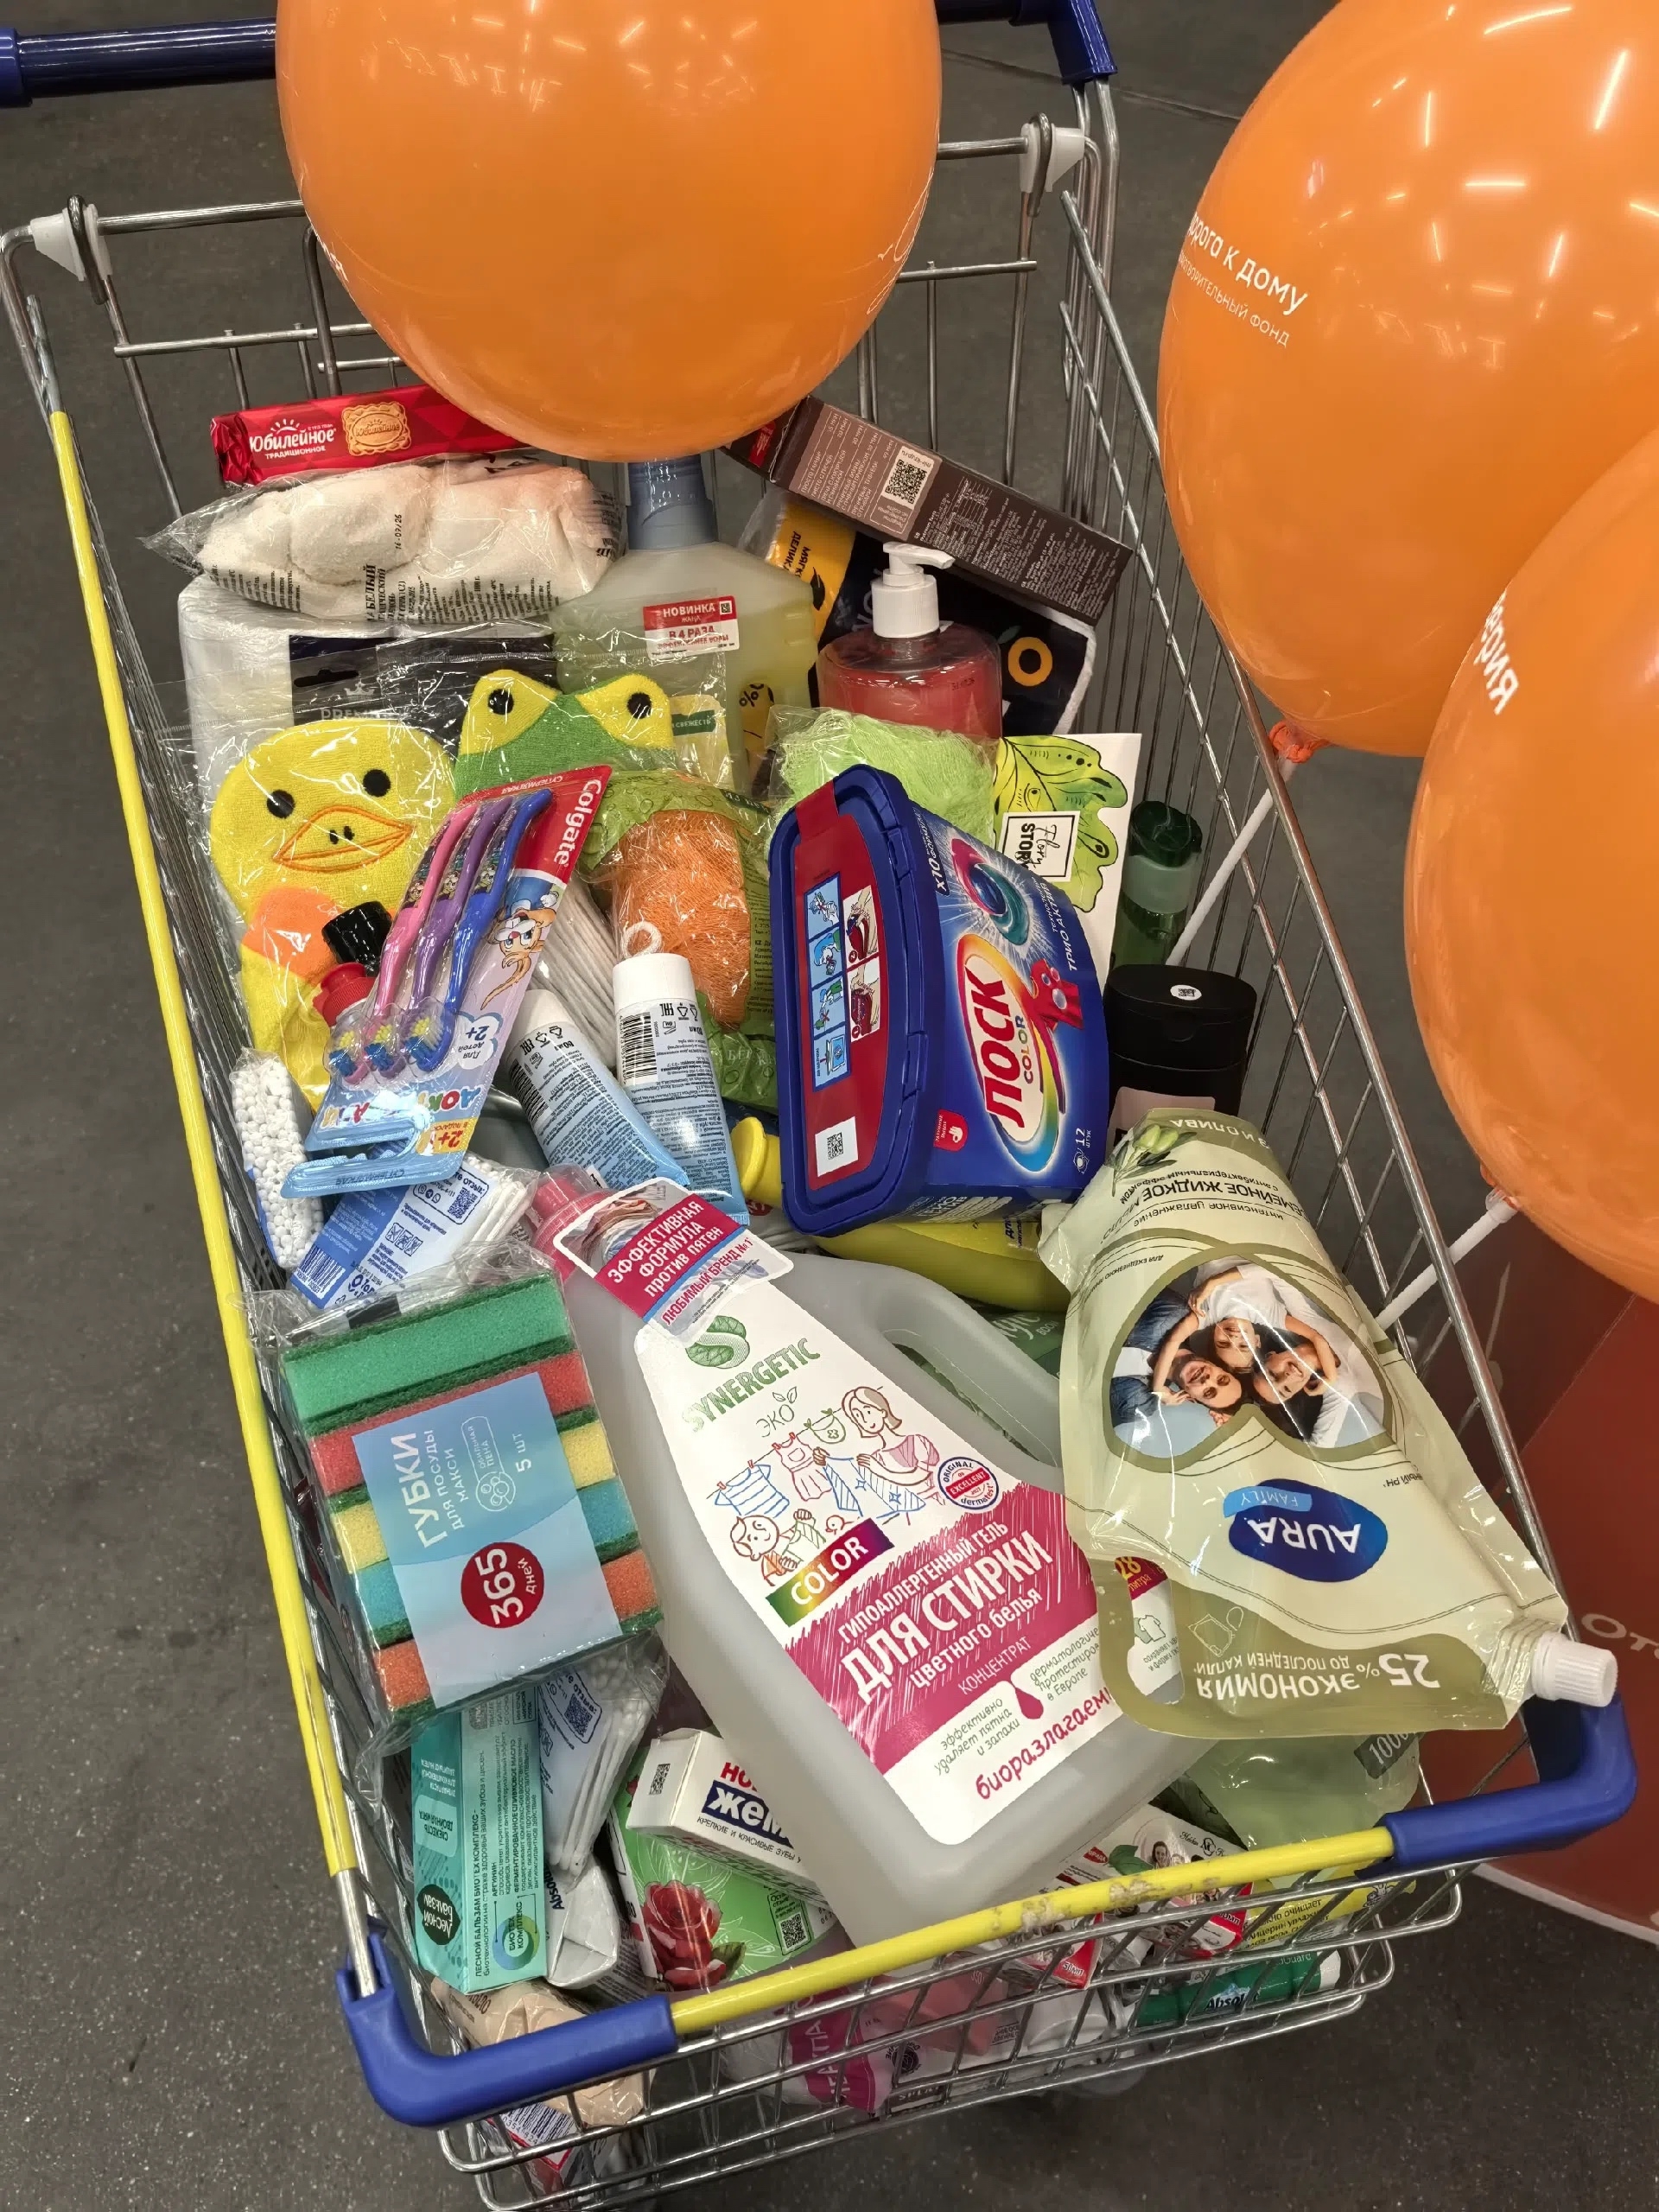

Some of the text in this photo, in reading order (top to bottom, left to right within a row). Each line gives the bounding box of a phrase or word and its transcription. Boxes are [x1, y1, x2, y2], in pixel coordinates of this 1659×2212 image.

[1249, 313, 1290, 348] ФОНД
[248, 424, 334, 452] Юбилейное
[264, 445, 326, 459] ТРАДИЦИОННОЕ
[361, 563, 376, 609] БЕЛЫЙ
[663, 602, 715, 617] НОВИНКА
[554, 780, 601, 867] Colgate
[1058, 929, 1077, 972] ТРИО
[464, 1025, 492, 1041] 2+
[967, 968, 1025, 1128] ЛОСК
[1015, 1016, 1036, 1084] COLOR
[1075, 1127, 1085, 1146] 12
[1168, 1119, 1237, 1134] ОЛИВА
[1140, 1174, 1222, 1203] ЖИДКОЕ
[1166, 1172, 1271, 1188] антибактериальным
[603, 1195, 705, 1285] ЭФФЕКТИВНАЯ
[635, 1217, 706, 1280] ФОРМУЛА
[644, 1251, 691, 1300] против
[686, 1223, 724, 1258] пятен
[659, 1269, 713, 1325] ЛЮБИМЫЙ
[707, 1246, 741, 1278] БРЕНД
[677, 1332, 823, 1434] SYNERGETIC
[442, 1446, 469, 1503] МАКСИ
[479, 1439, 496, 1467] ПЕНА
[514, 1457, 532, 1472] 5
[943, 1460, 974, 1482] ORIGINAL
[386, 1428, 448, 1549] ГУБКИ
[420, 1428, 466, 1529] ДЛЯ ПОСУДЫ
[950, 1471, 986, 1494] EXCELLENT
[1240, 1490, 1299, 1506] FAMILY
[1247, 1515, 1361, 1553] AURA
[473, 1544, 526, 1625] 365
[790, 1537, 869, 1609] COLOR
[834, 1516, 1009, 1644] ГИПОАЛЛЕРГЕННЫЙ ГЕЛЬ
[839, 1522, 1055, 1706] ДЛЯ СТИРКИ
[906, 1581, 1044, 1693] цветного белья
[956, 1634, 1036, 1698] КОНЦЕНТРАТ
[1027, 1625, 1103, 1683] дерматологиче
[1035, 1640, 1104, 1694] протестиров
[1196, 1650, 1350, 1674] ДО ПОСЛЕДНЕЙ КАПЛИ
[1052, 1665, 1090, 1698] Европе
[1194, 1670, 1359, 1700] ЭКОНОМИЯ
[933, 1708, 1015, 1777] удаляет пятна
[937, 1695, 1007, 1751] эффективно
[982, 1716, 1023, 1751] запахи
[479, 1783, 487, 1806] зубов
[696, 1815, 728, 1834] КРЕПКИЕ
[737, 1832, 774, 1853] КРАСИВЫЕ
[774, 1847, 795, 1861] ЗУБЫ
